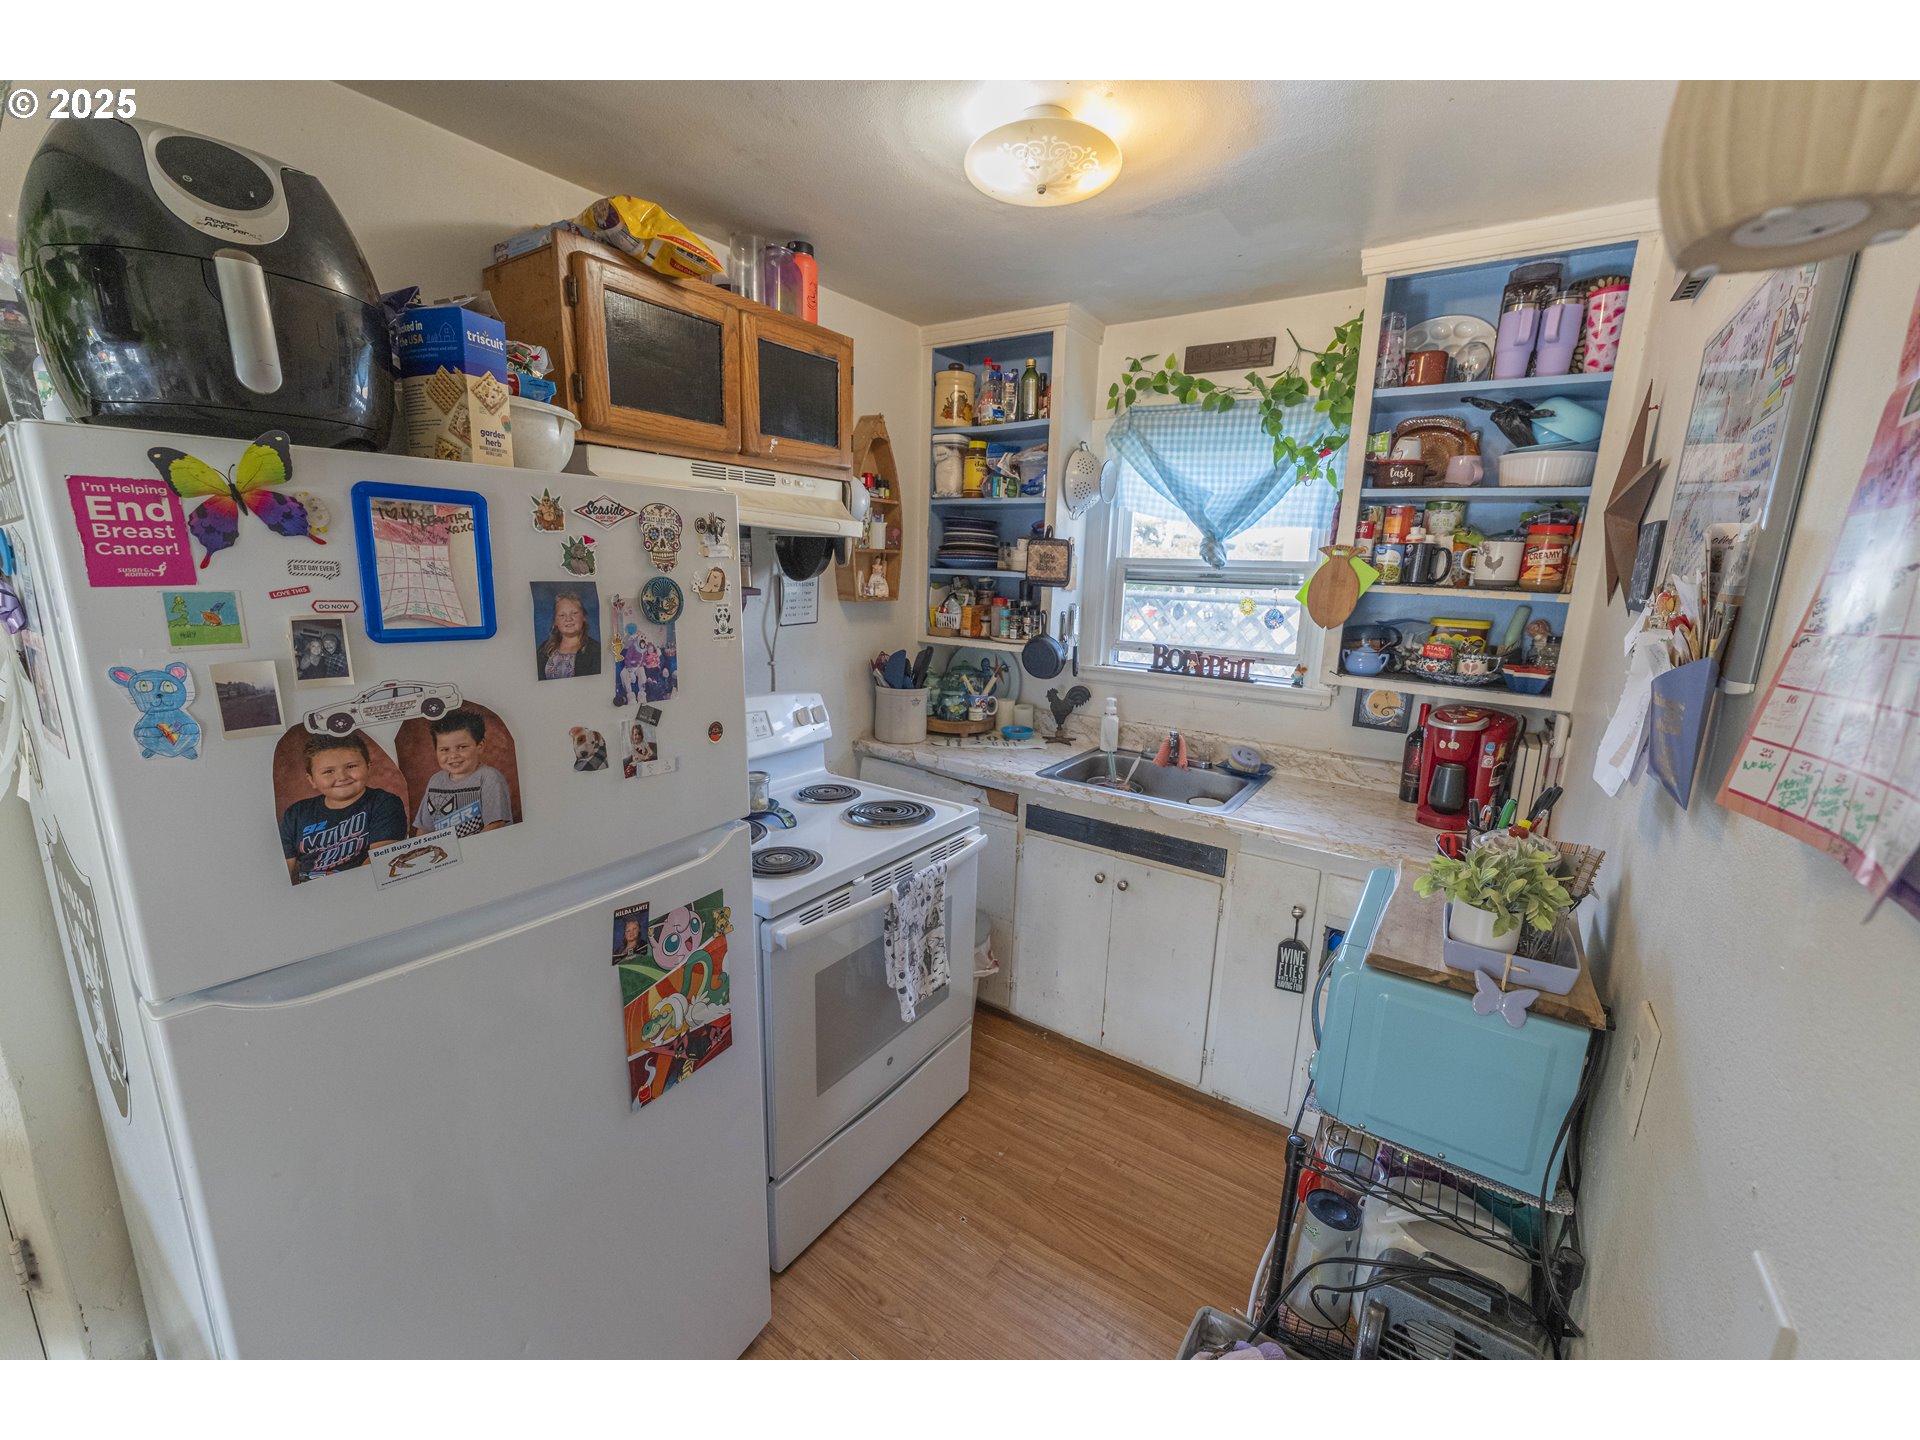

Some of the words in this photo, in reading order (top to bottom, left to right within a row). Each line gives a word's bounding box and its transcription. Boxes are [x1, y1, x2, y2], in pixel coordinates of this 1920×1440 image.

[205, 216, 238, 227] Power
[399, 321, 414, 332] aked
[415, 320, 423, 330] in
[409, 333, 424, 345] USA
[466, 330, 504, 351] triscuit
[480, 428, 506, 440] garden
[485, 438, 502, 448] herb
[1390, 467, 1415, 482] tasty
[81, 482, 105, 492] I'm
[110, 483, 168, 496] Helping
[84, 495, 173, 522] End
[585, 500, 626, 516] Seaside
[91, 523, 176, 539] Breast
[95, 542, 180, 555] Cancer!
[1529, 551, 1561, 560] CREAMY
[272, 590, 290, 598] LOVE
[291, 587, 308, 595] THIS
[1785, 694, 1799, 704] 16
[1759, 747, 1775, 759] 23
[373, 847, 389, 857] Bell
[391, 841, 412, 852] Buoy
[423, 831, 452, 843] Seaside
[615, 908, 631, 917] HILDA
[1281, 947, 1306, 967] WINE
[1279, 962, 1304, 980] FLIES
